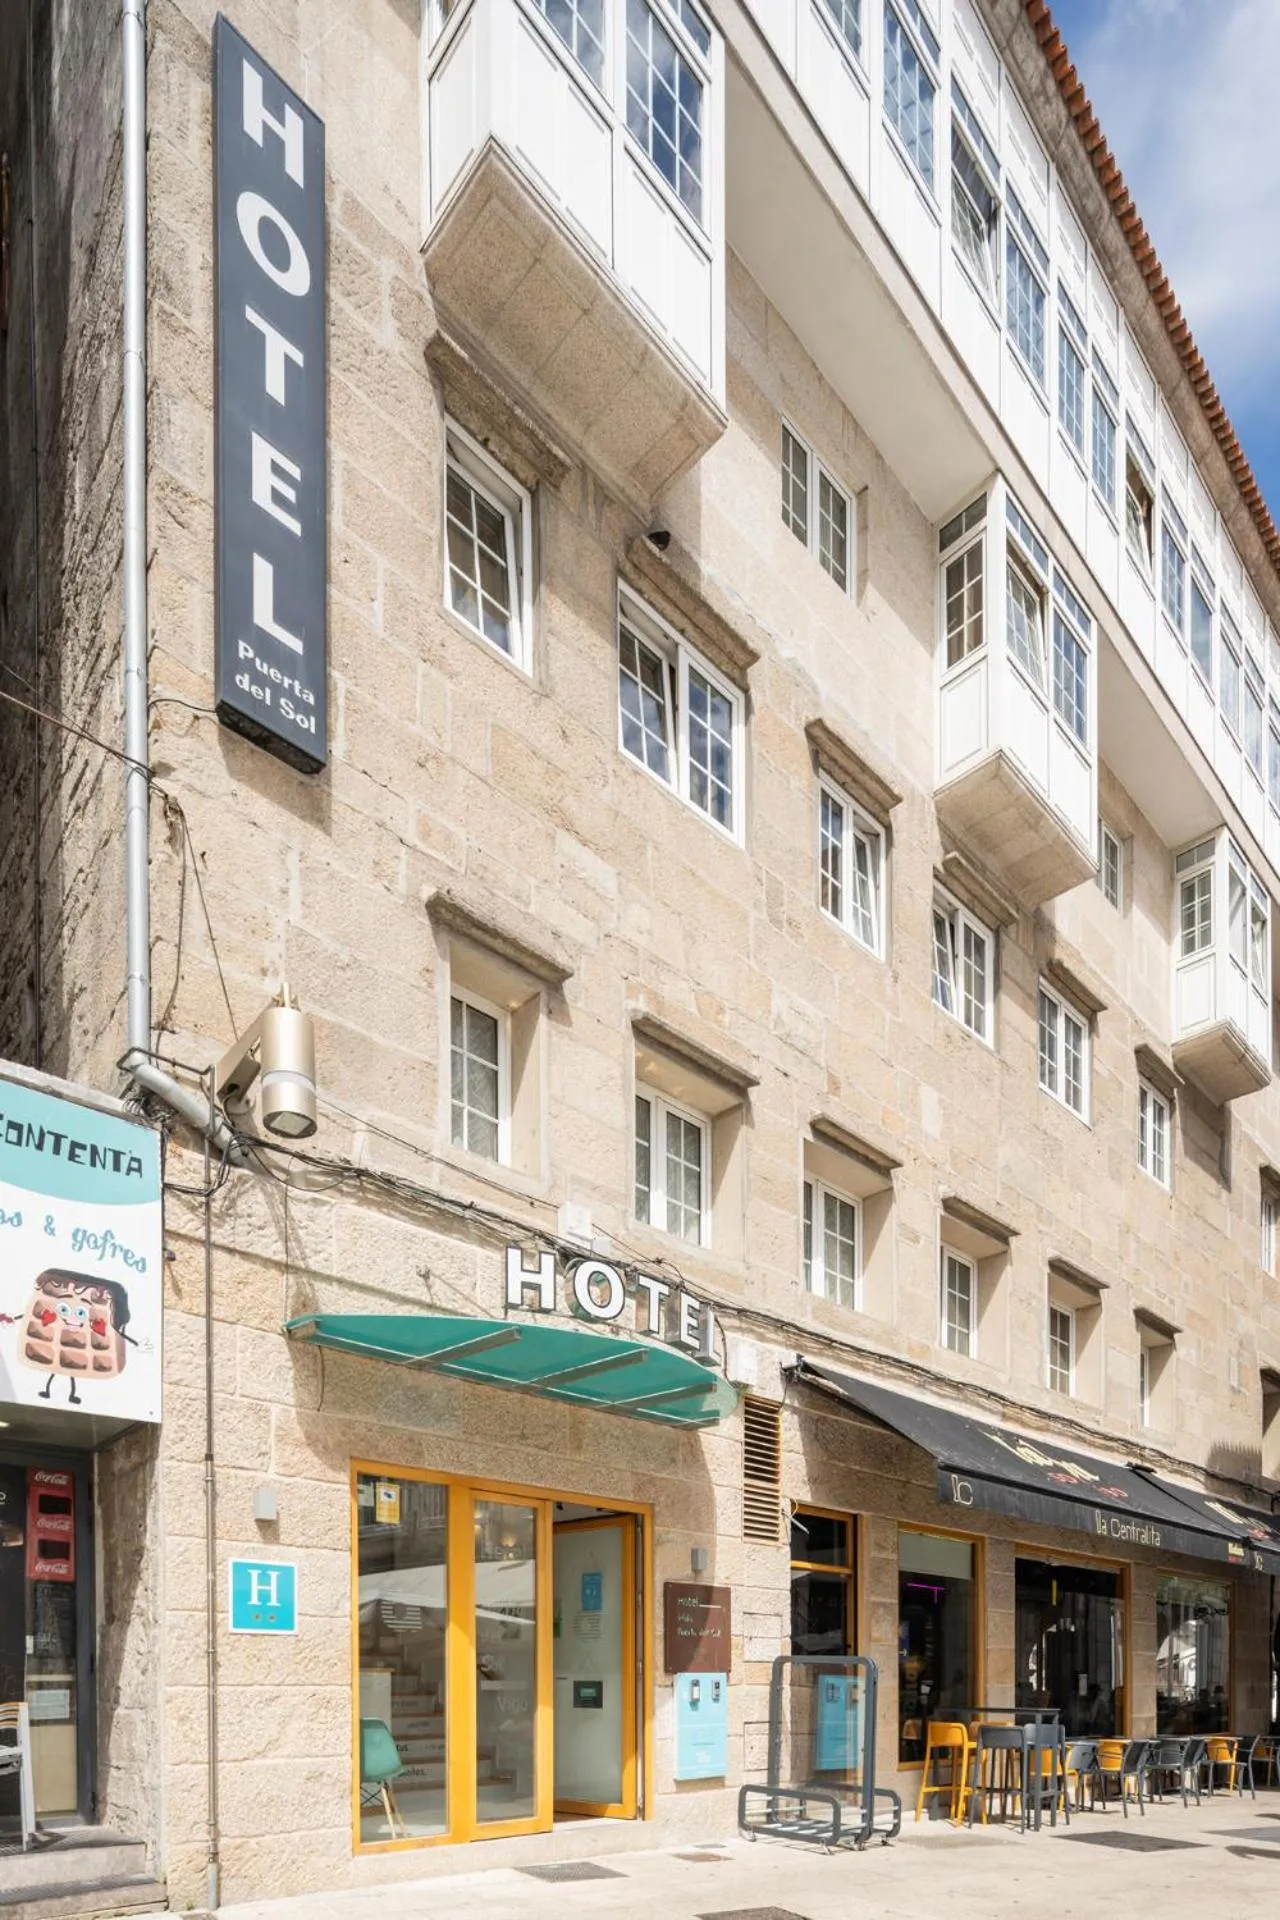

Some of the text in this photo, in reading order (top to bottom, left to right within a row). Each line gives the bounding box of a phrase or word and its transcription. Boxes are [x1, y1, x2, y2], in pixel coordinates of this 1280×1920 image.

[236, 58, 311, 655] HOTEL
[235, 672, 316, 735] del Sol
[238, 639, 315, 706] Puerta
[44, 1215, 56, 1236] &
[505, 1246, 722, 1366] HOTEL
[247, 1569, 282, 1606] H
